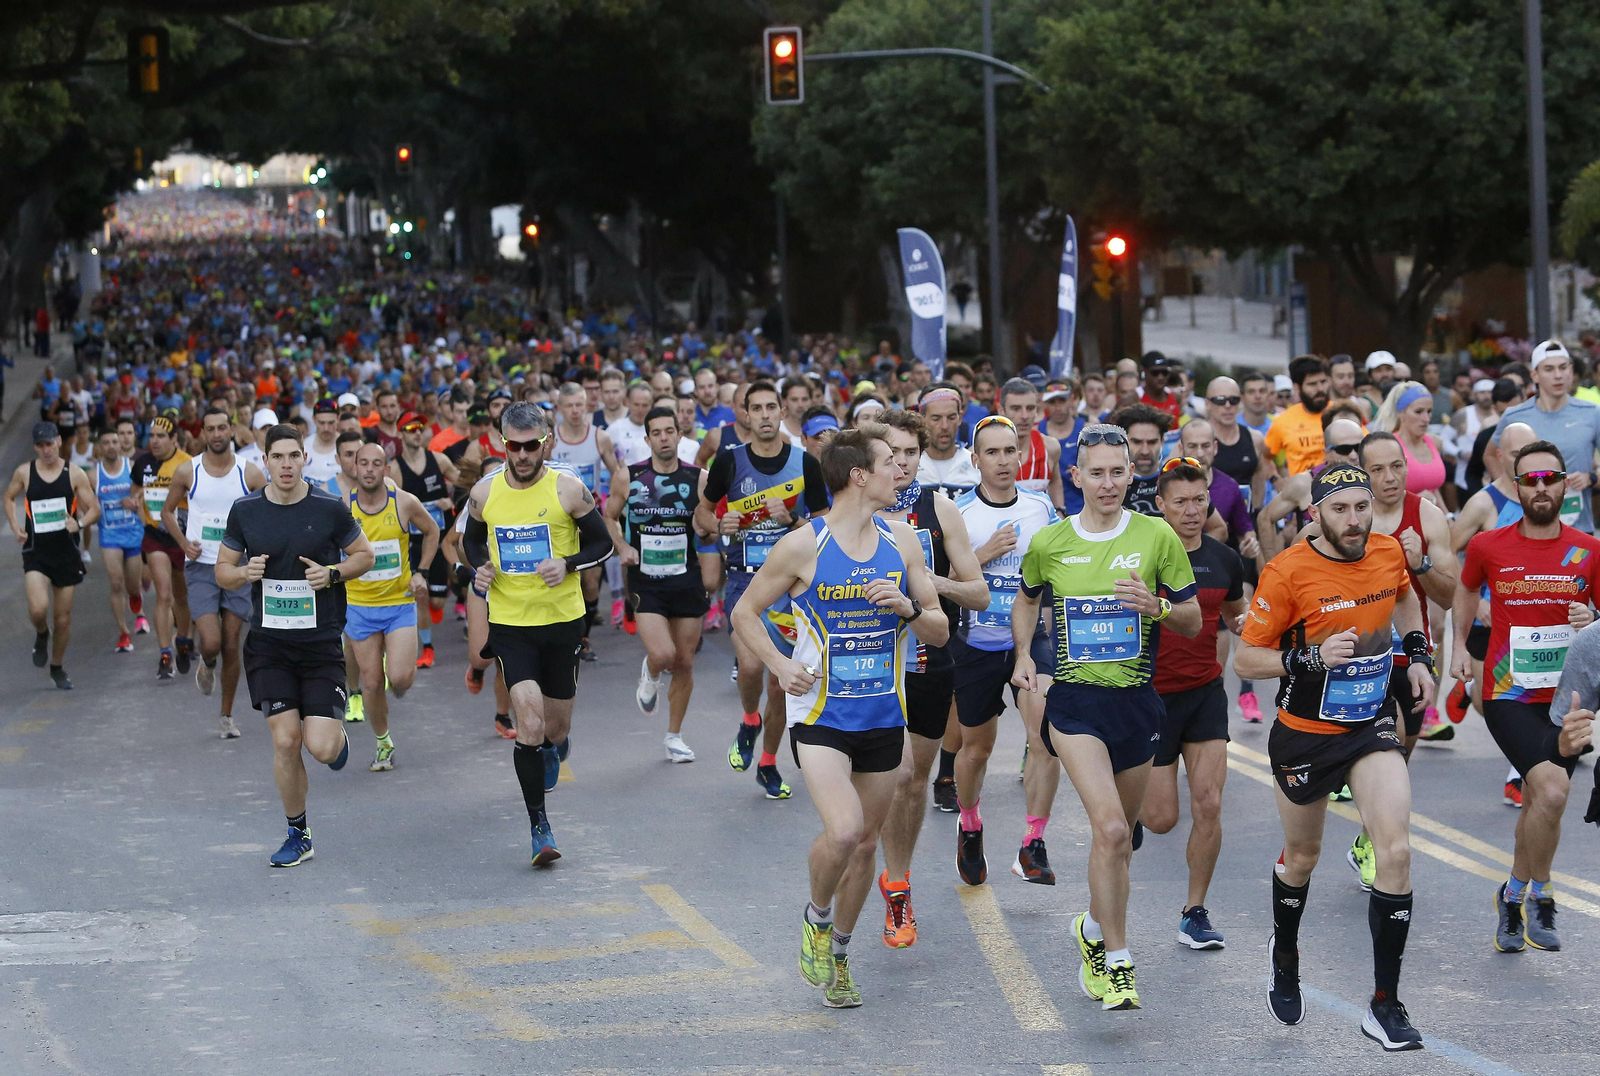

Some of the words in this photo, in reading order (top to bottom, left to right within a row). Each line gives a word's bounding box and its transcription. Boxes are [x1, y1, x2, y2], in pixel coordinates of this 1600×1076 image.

[644, 525, 686, 533] millenium
[514, 544, 532, 554] 508
[1109, 553, 1141, 570] AG
[1515, 580, 1579, 595] Sightseeing
[1319, 594, 1342, 604] Team
[276, 600, 299, 609] 5173
[1094, 604, 1123, 612] ZURICH
[826, 610, 841, 619] The
[837, 620, 846, 629] in
[847, 619, 881, 629] Brussels
[1091, 622, 1114, 634] 401
[1543, 632, 1570, 640] ZURICH
[857, 640, 883, 648] ZURICH
[1532, 651, 1559, 663] 5001
[854, 657, 875, 670] 170
[1358, 663, 1384, 673] ZURICH
[1352, 682, 1375, 696] 328
